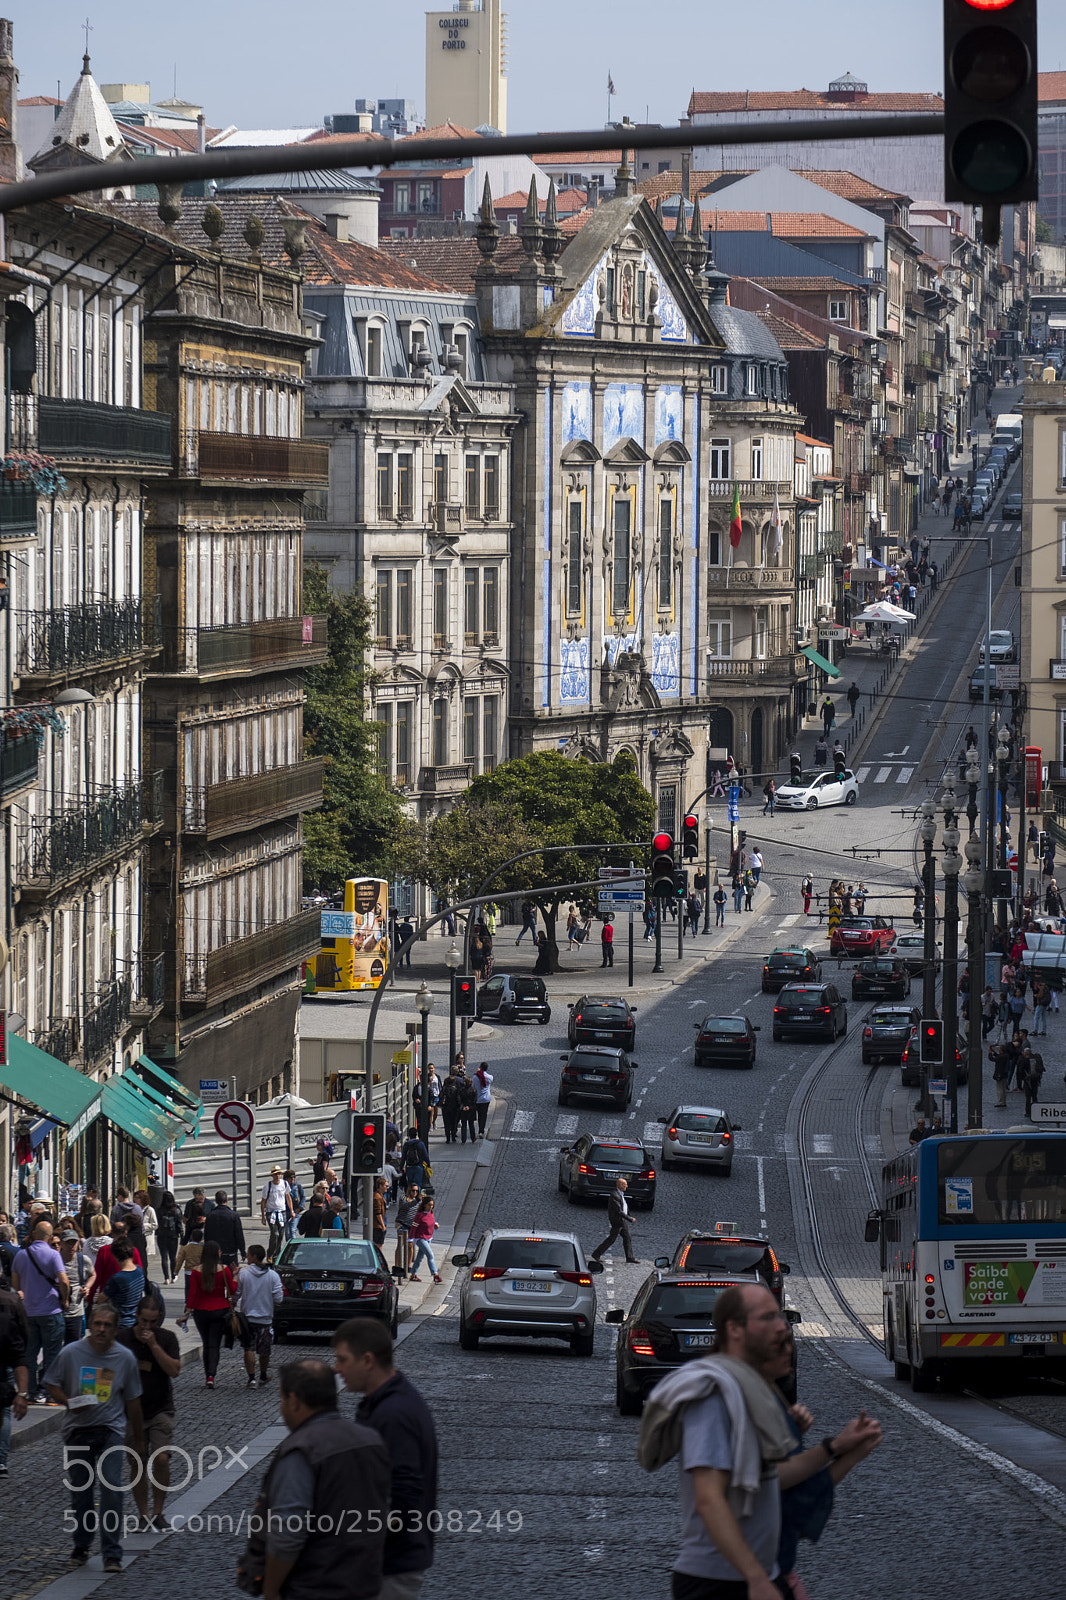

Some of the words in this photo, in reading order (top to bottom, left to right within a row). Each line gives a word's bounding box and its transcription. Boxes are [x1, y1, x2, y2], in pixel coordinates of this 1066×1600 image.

[439, 18, 469, 28] COLISEU
[448, 29, 459, 39] DO
[442, 40, 466, 50] PORTO
[969, 1265, 1009, 1278] Saiba
[969, 1278, 1004, 1290] onde
[969, 1291, 1009, 1301] votar
